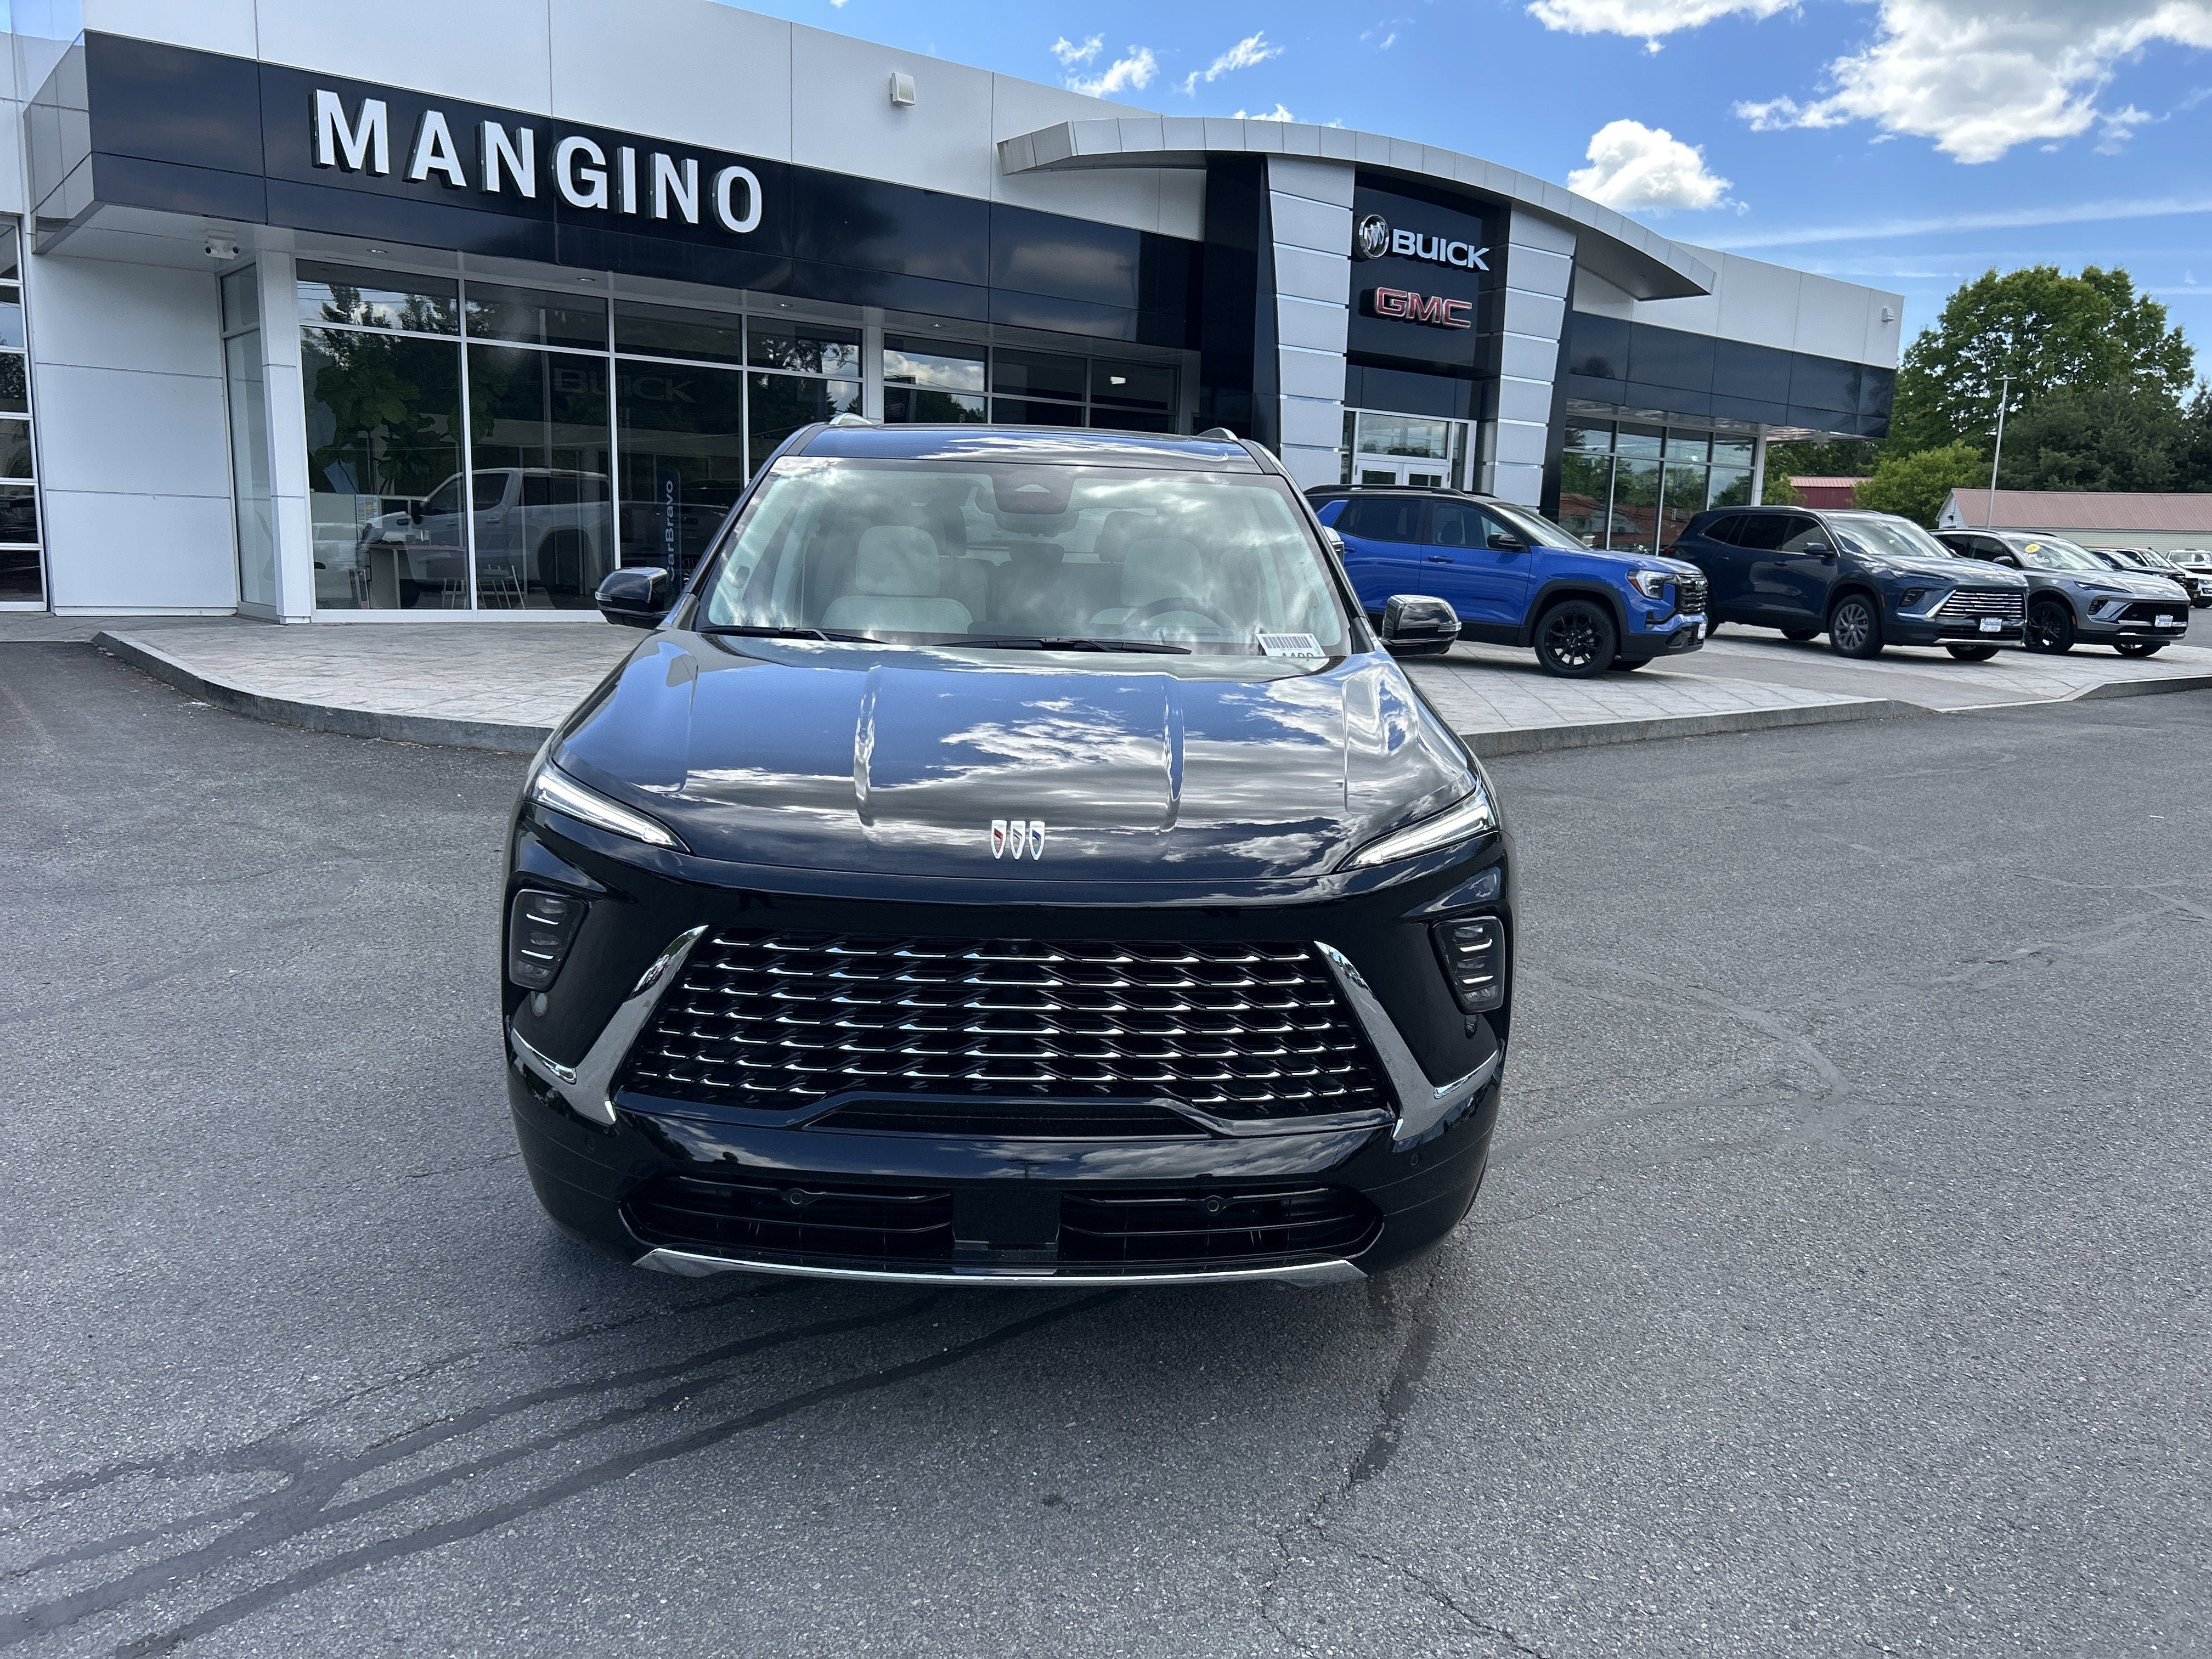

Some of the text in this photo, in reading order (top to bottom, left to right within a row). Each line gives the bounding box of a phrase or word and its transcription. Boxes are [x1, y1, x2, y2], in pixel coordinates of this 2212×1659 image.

[314, 88, 763, 234] MANGINO
[1392, 228, 1490, 271] BUICK
[1374, 286, 1472, 329] GMC
